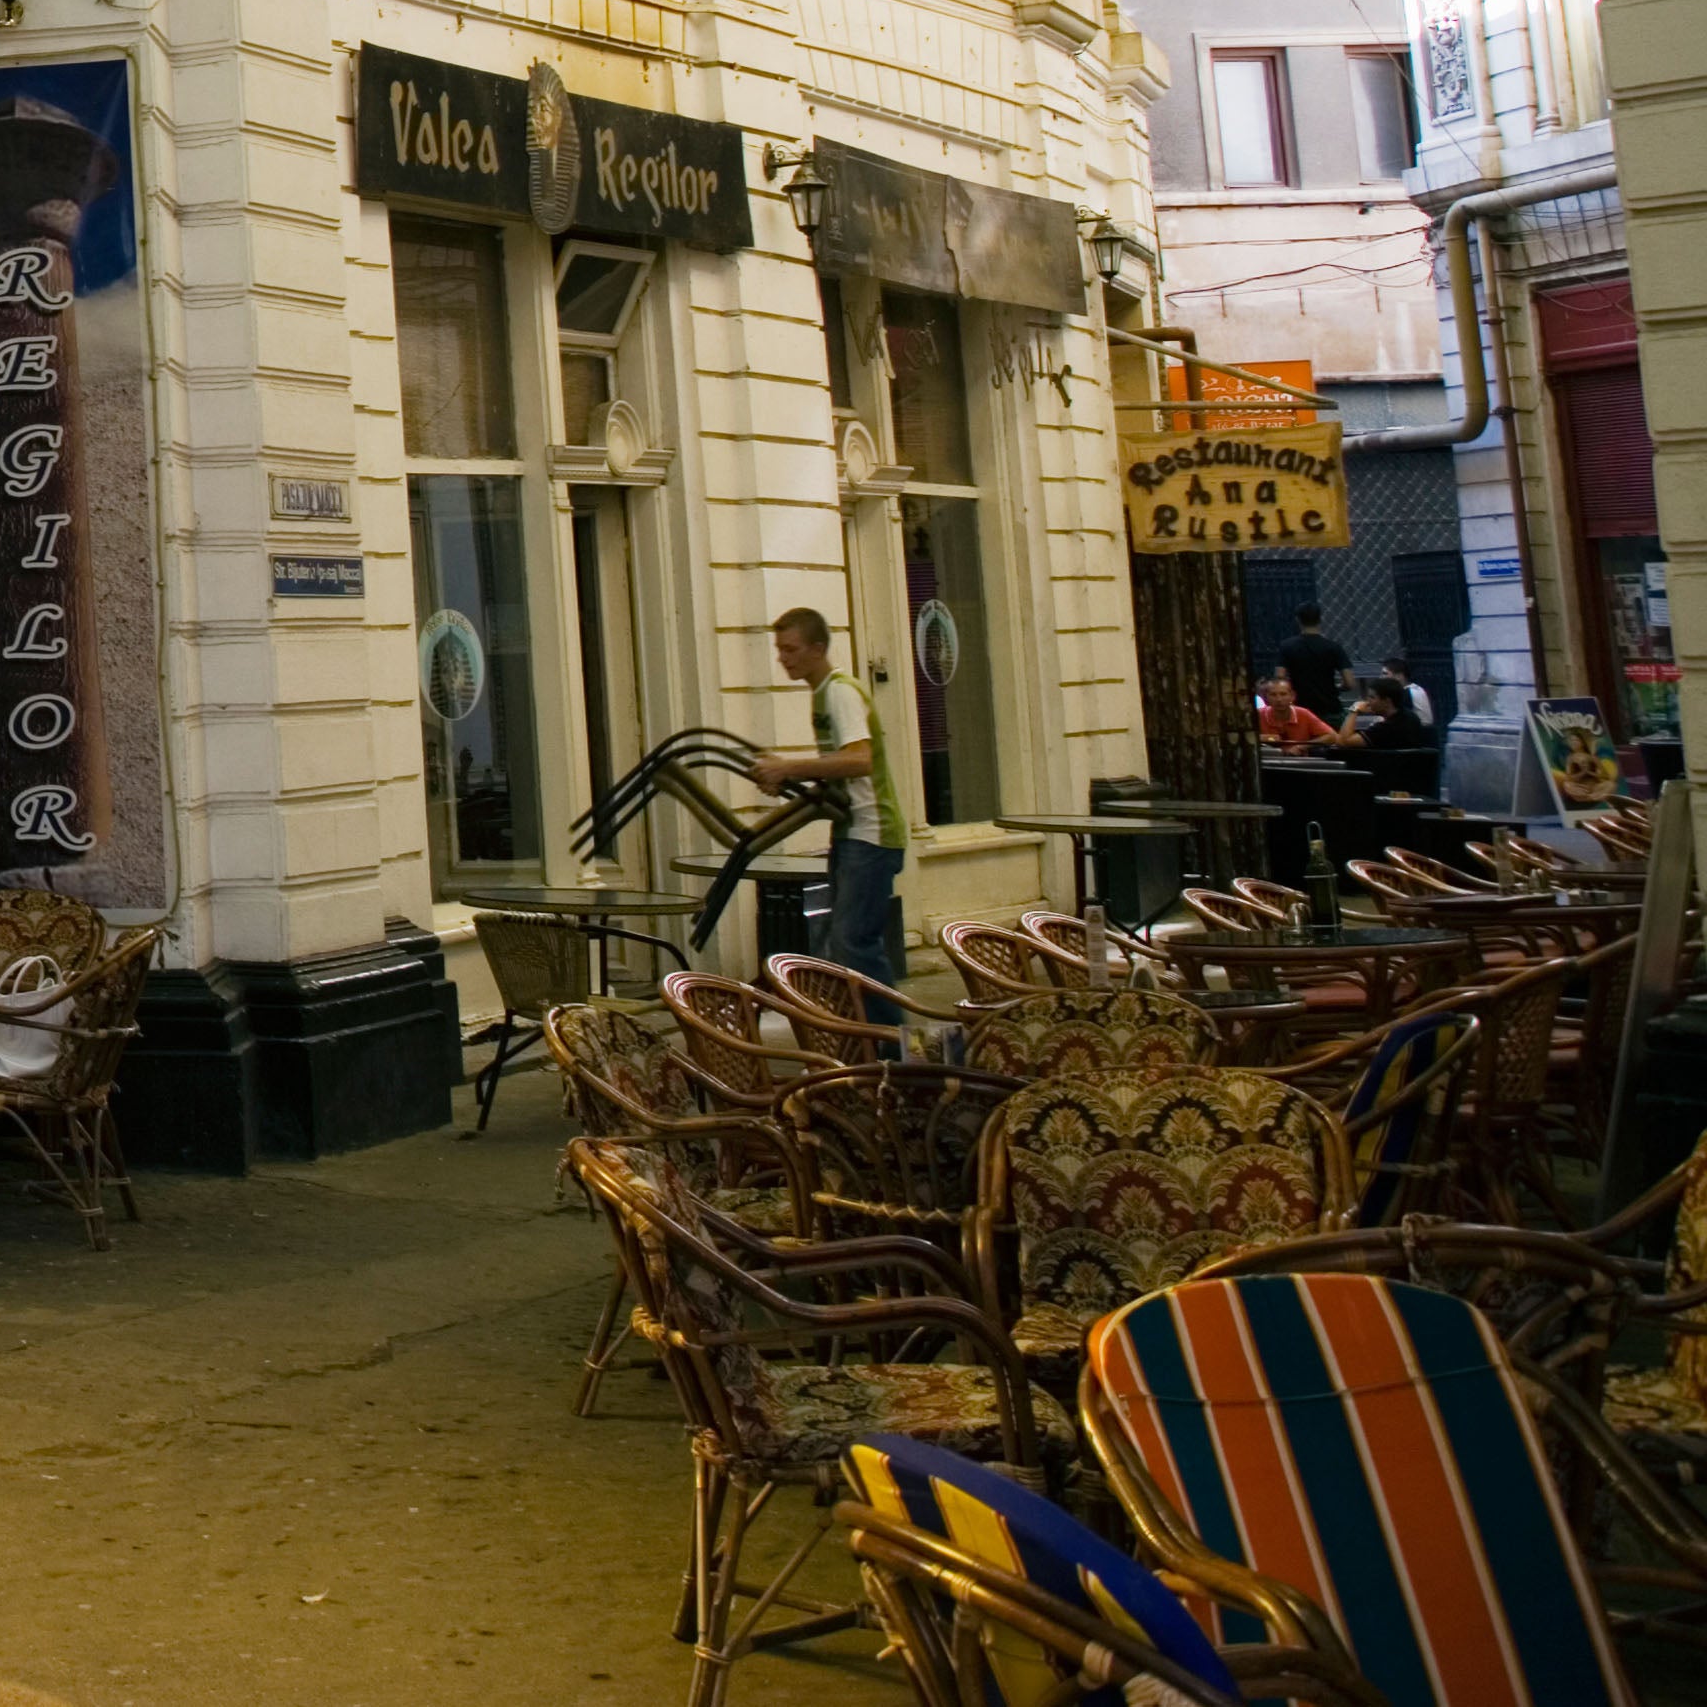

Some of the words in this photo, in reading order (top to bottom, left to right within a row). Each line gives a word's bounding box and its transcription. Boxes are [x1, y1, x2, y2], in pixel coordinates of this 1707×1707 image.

[390, 79, 499, 175] Valea
[594, 127, 718, 228] Regilor
[1128, 436, 1337, 495] Restaurant
[1185, 474, 1277, 505] Ana
[1152, 504, 1326, 543] Rustic
